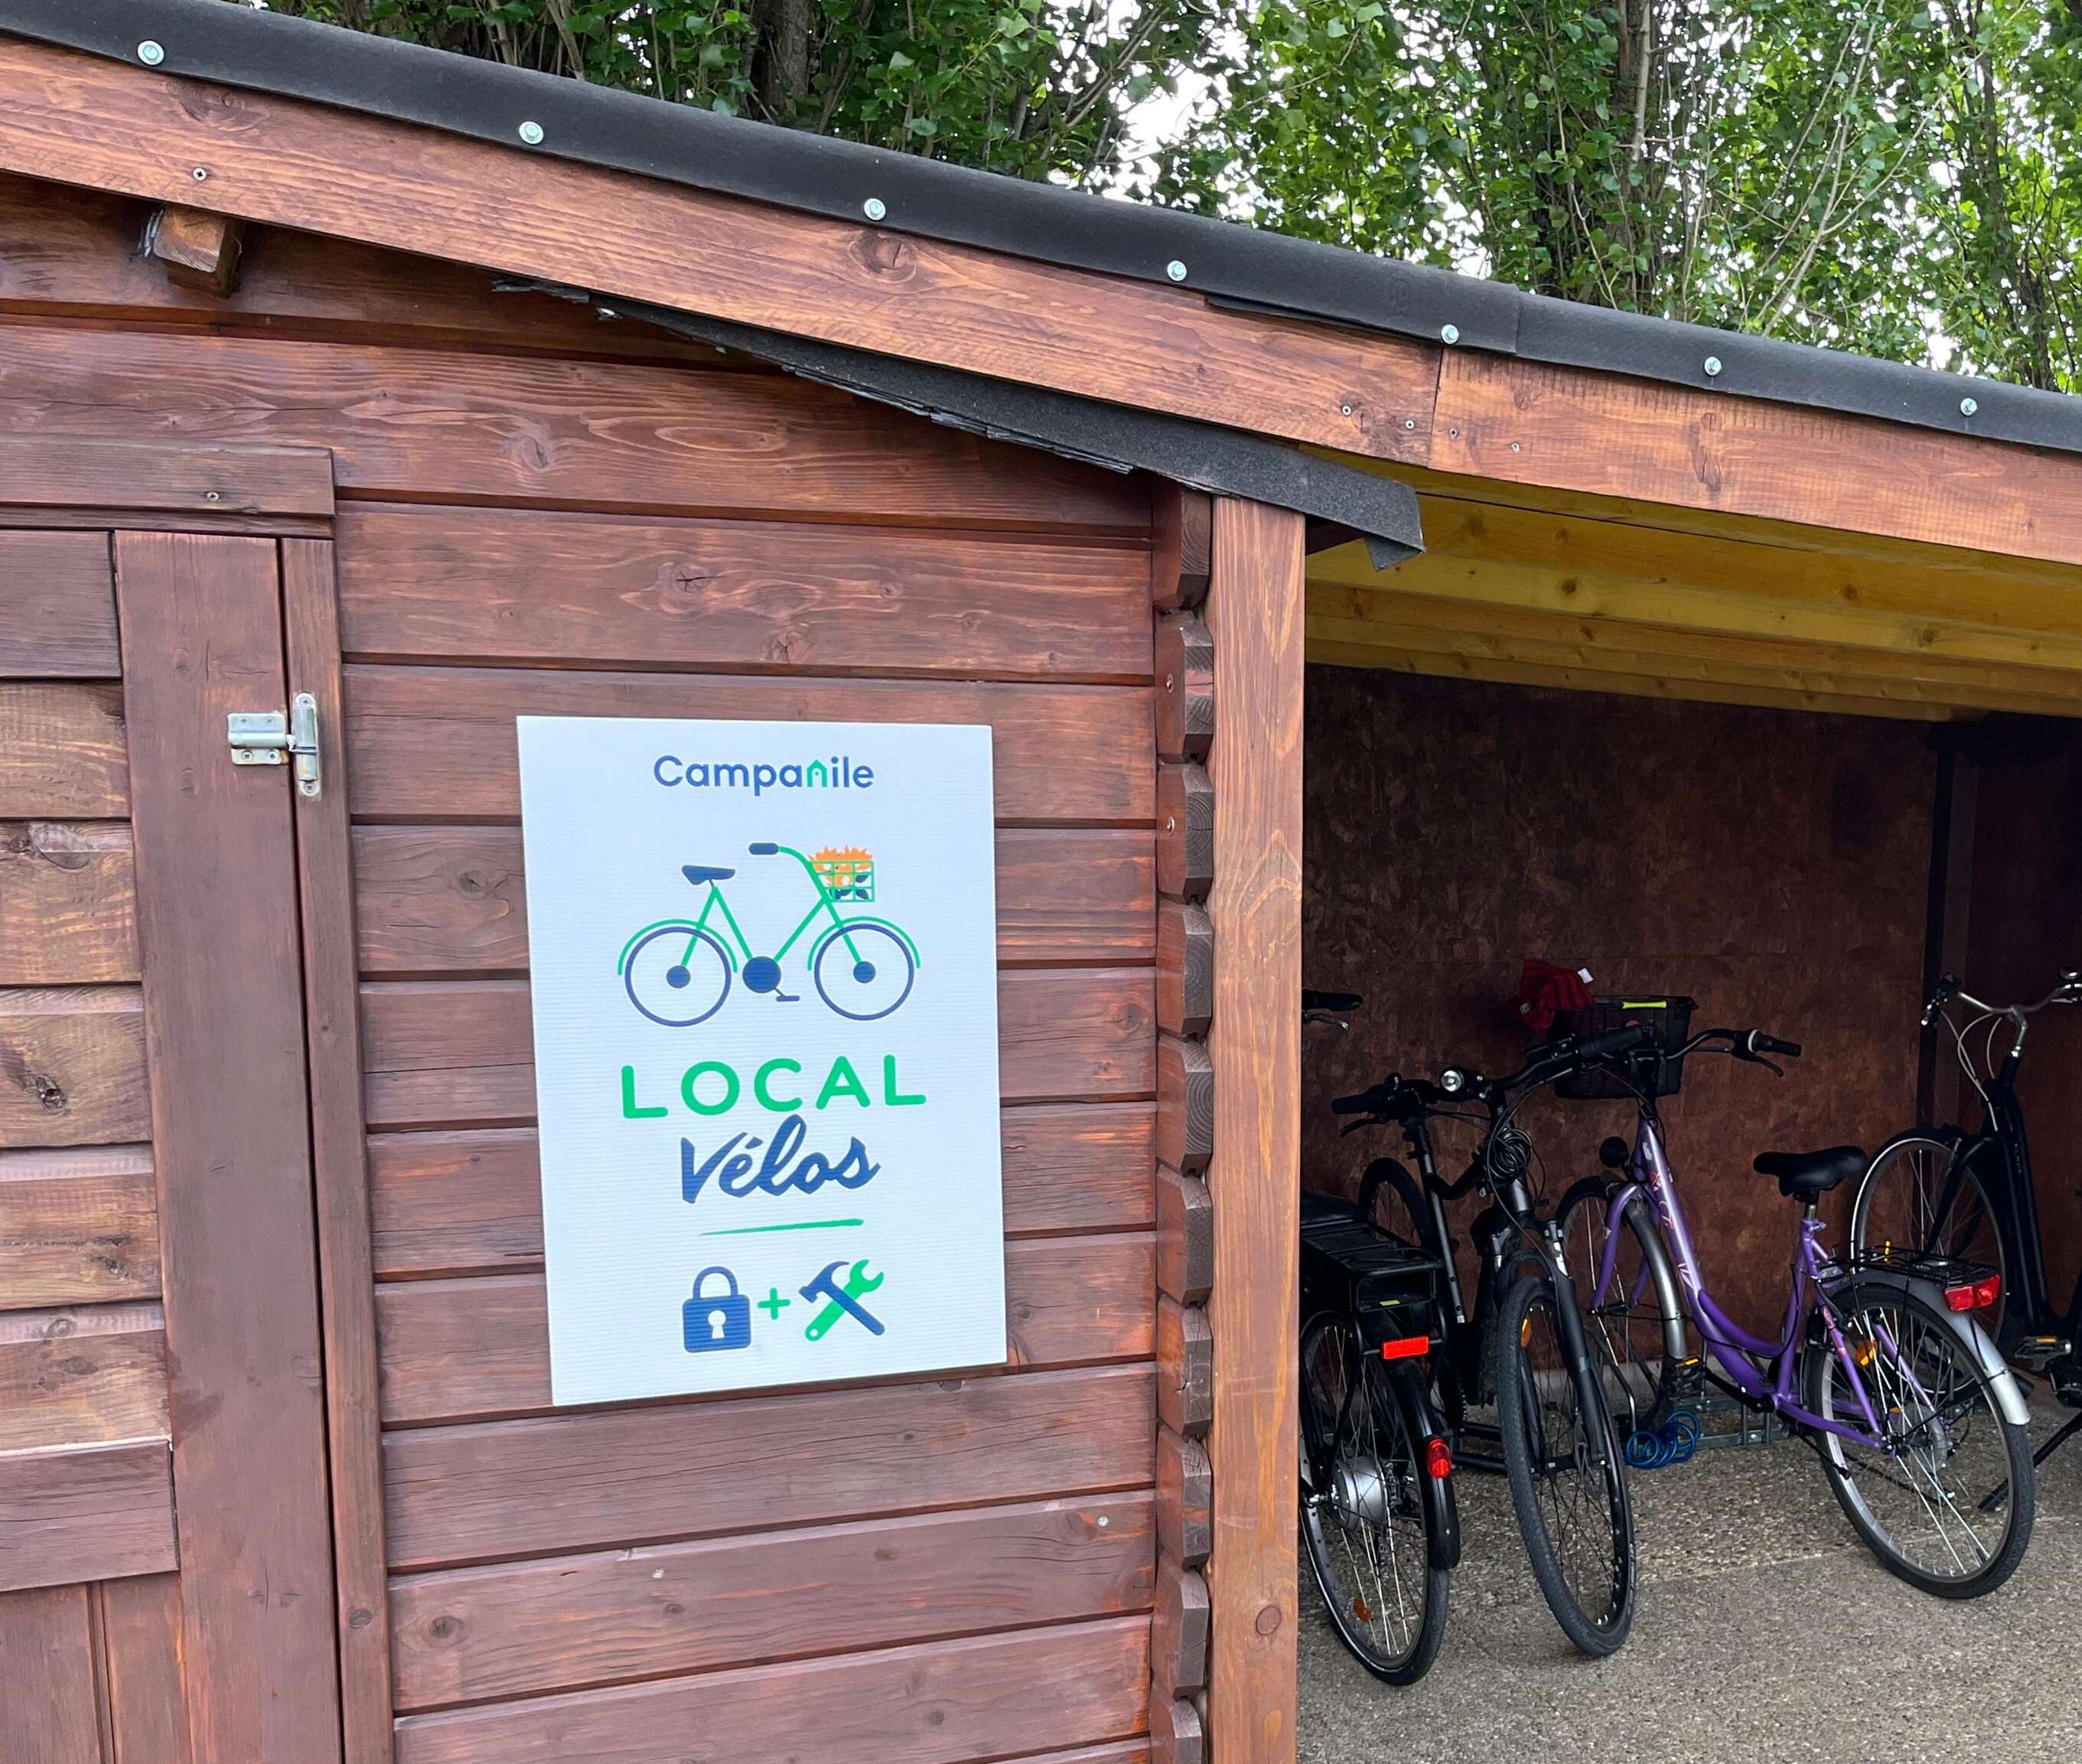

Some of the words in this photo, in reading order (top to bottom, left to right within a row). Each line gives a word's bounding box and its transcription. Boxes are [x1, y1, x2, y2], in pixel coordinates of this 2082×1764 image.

[653, 755, 875, 797] Campanile
[619, 1053, 928, 1120] LOCAL
[680, 1115, 881, 1205] Vélos
